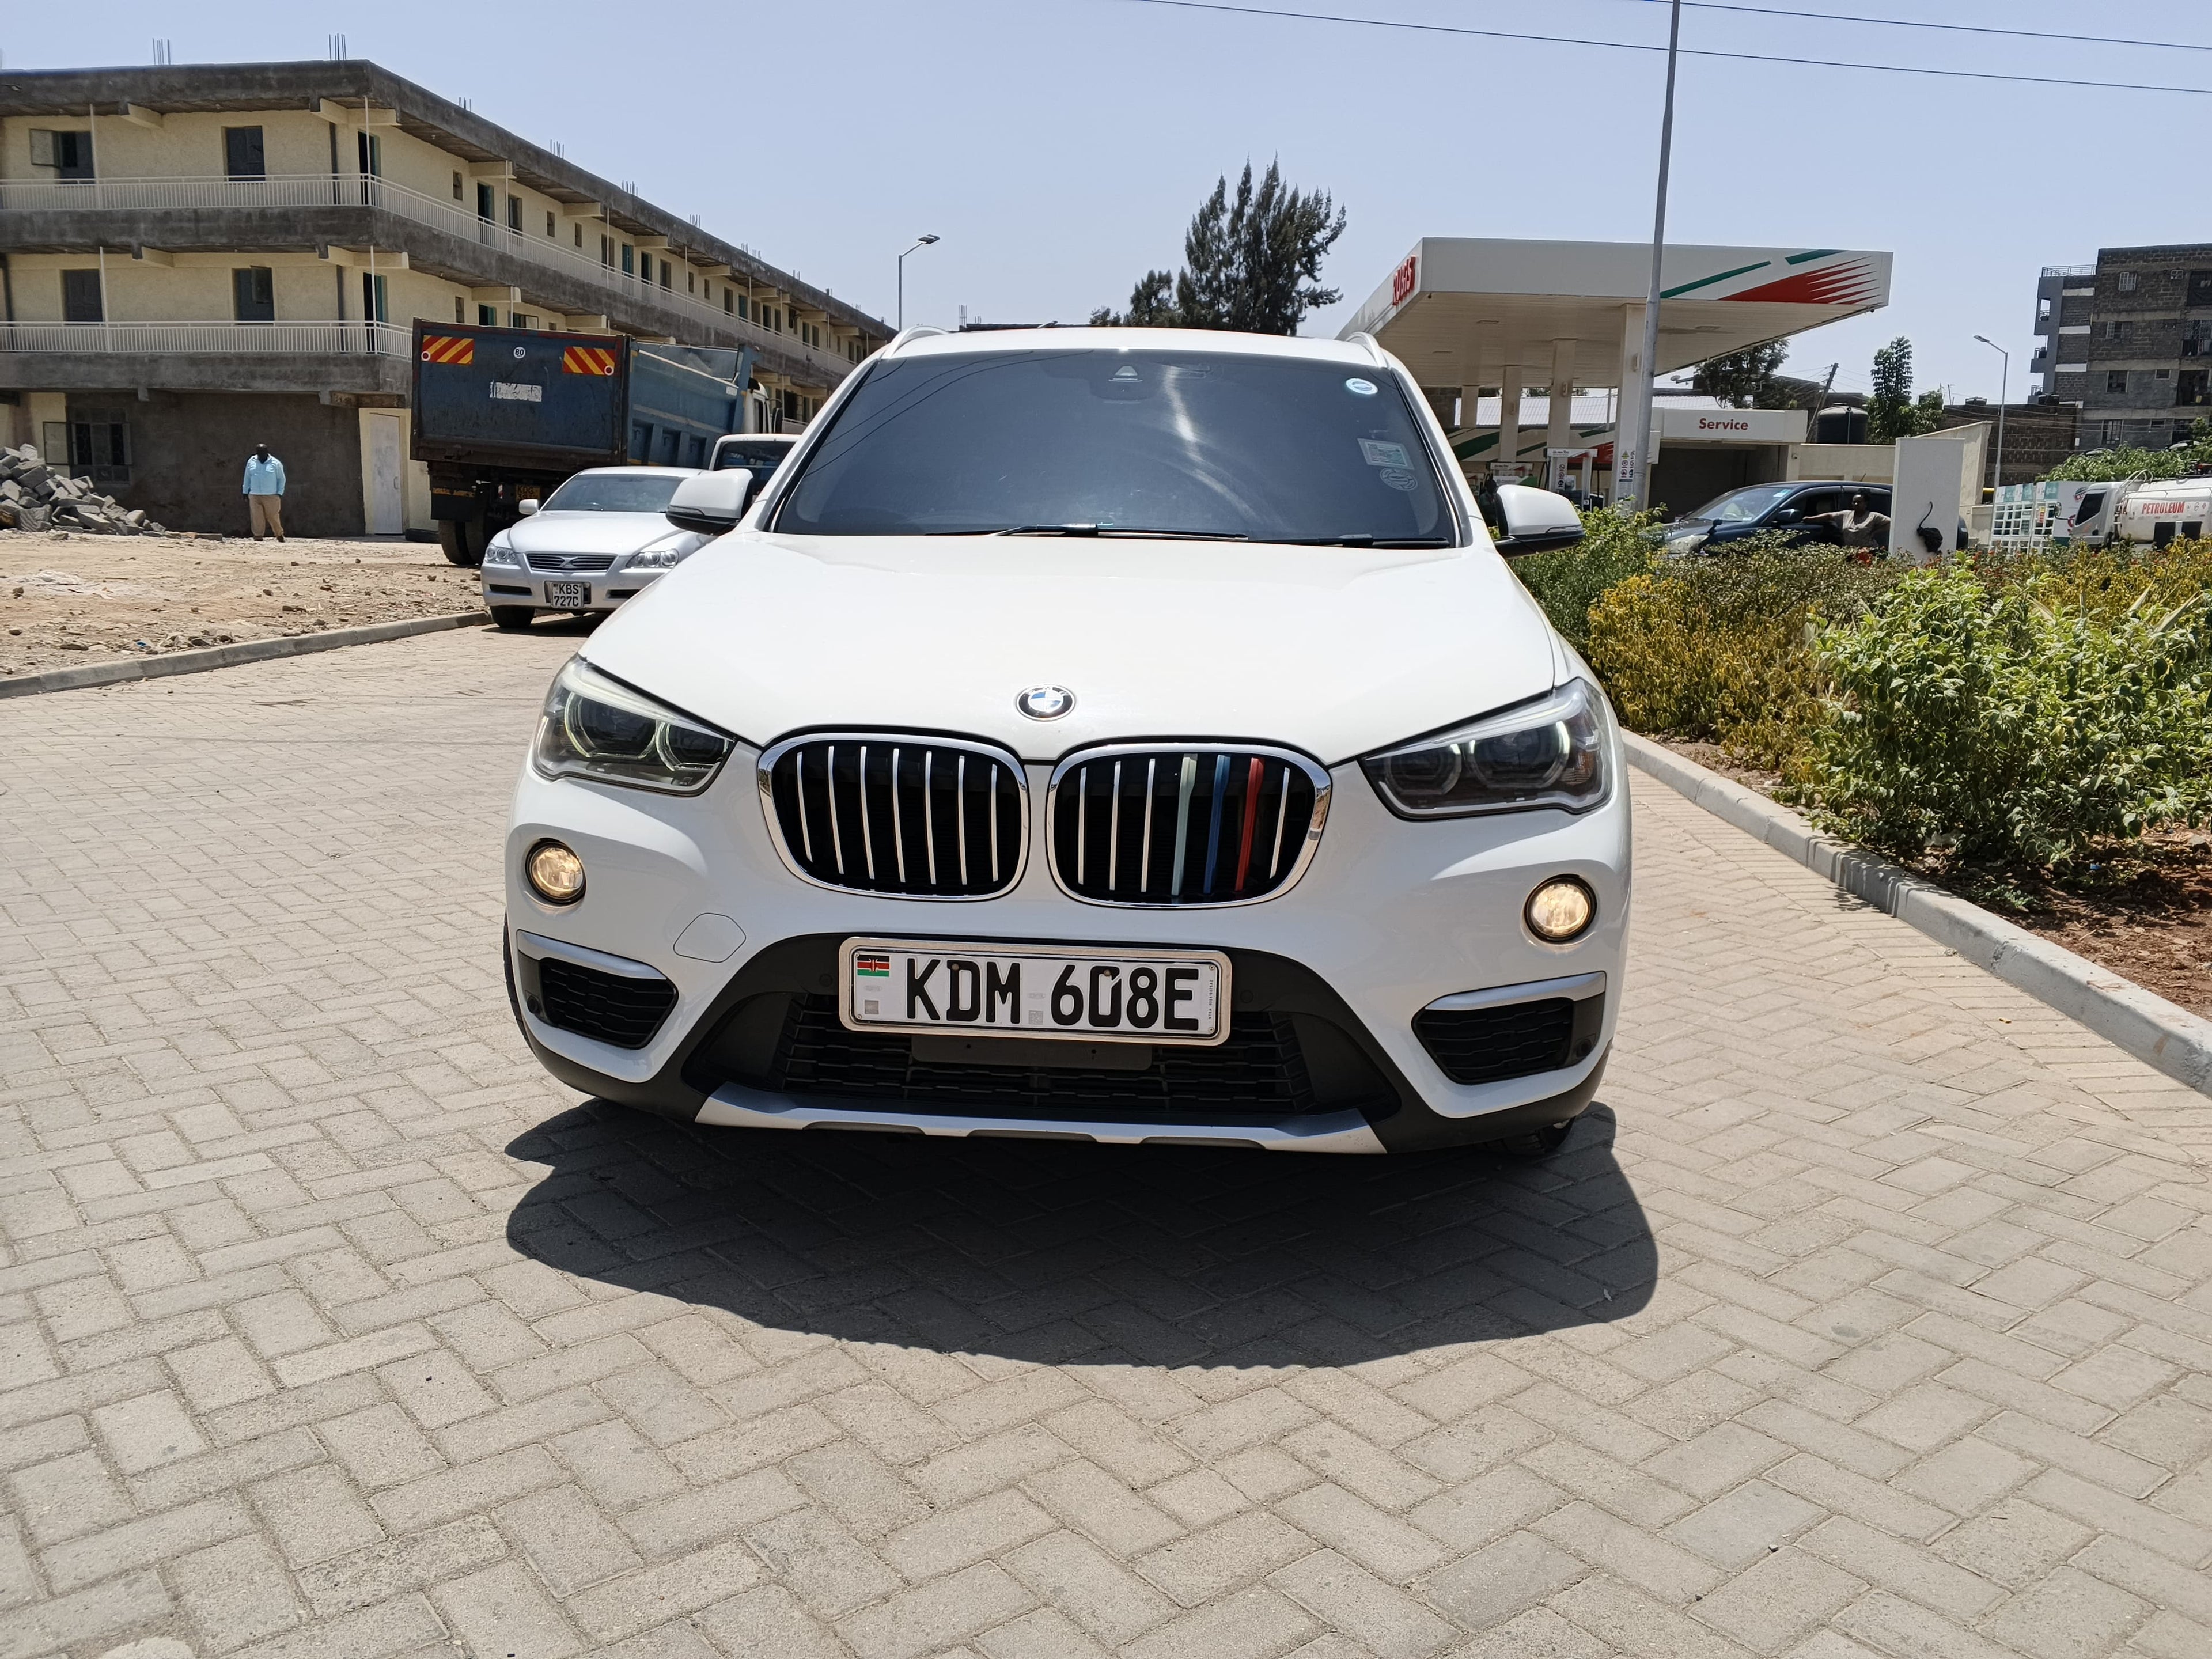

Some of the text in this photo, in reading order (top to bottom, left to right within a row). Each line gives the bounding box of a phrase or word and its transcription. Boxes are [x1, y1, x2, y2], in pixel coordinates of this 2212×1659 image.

[1699, 418, 1748, 430] Service
[2142, 502, 2185, 514] PETROLEUM
[559, 584, 578, 594] KBS
[554, 596, 578, 606] 727C
[906, 957, 1199, 1031] KDM 608E
